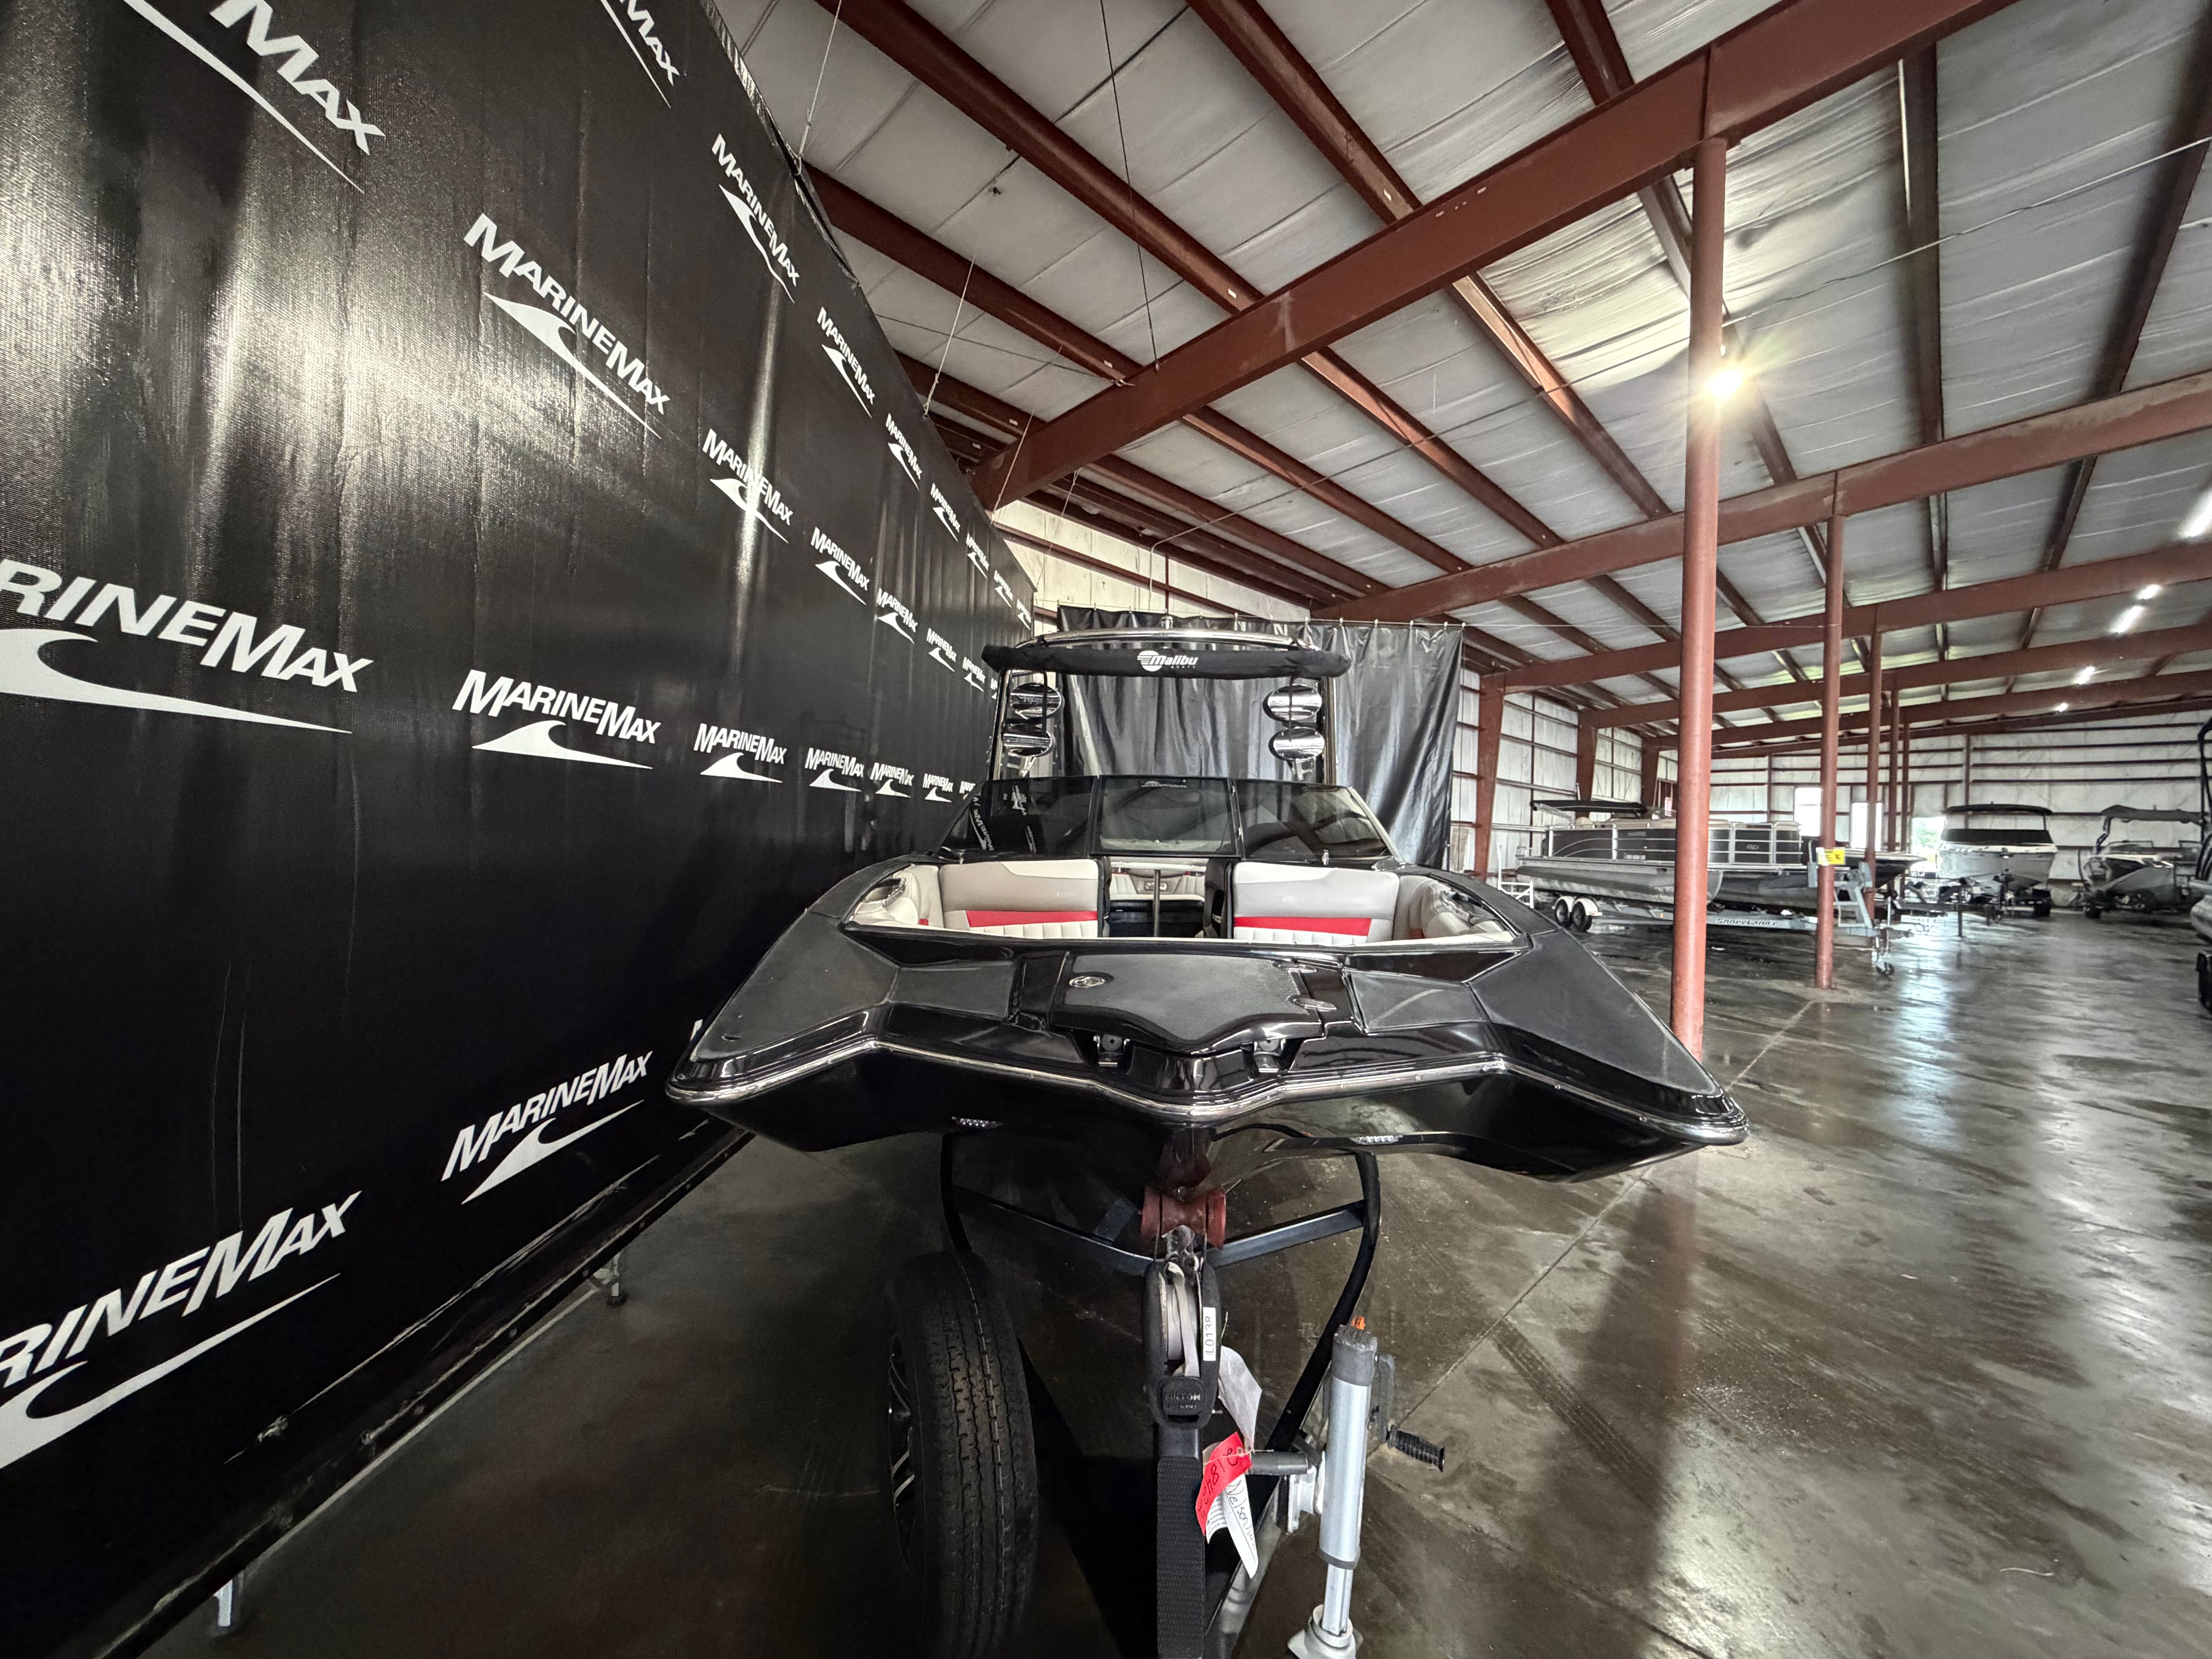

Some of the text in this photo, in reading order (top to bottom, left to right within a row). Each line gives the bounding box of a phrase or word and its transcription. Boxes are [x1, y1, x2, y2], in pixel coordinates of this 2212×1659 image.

[711, 133, 800, 287] MARINEMAX
[464, 213, 671, 415] MARINEMAX
[817, 306, 876, 405] MARINEMAX
[702, 428, 794, 526] MARINEMAX
[885, 413, 922, 480] MARINEMAX
[811, 526, 870, 591] MARINEMAX
[877, 587, 918, 633] MARINEMAX
[452, 669, 661, 744] MARINEMAX
[693, 723, 787, 764] MARINEMAX
[804, 747, 864, 779] MARINEMAX
[441, 1050, 653, 1182] MARINEMAX
